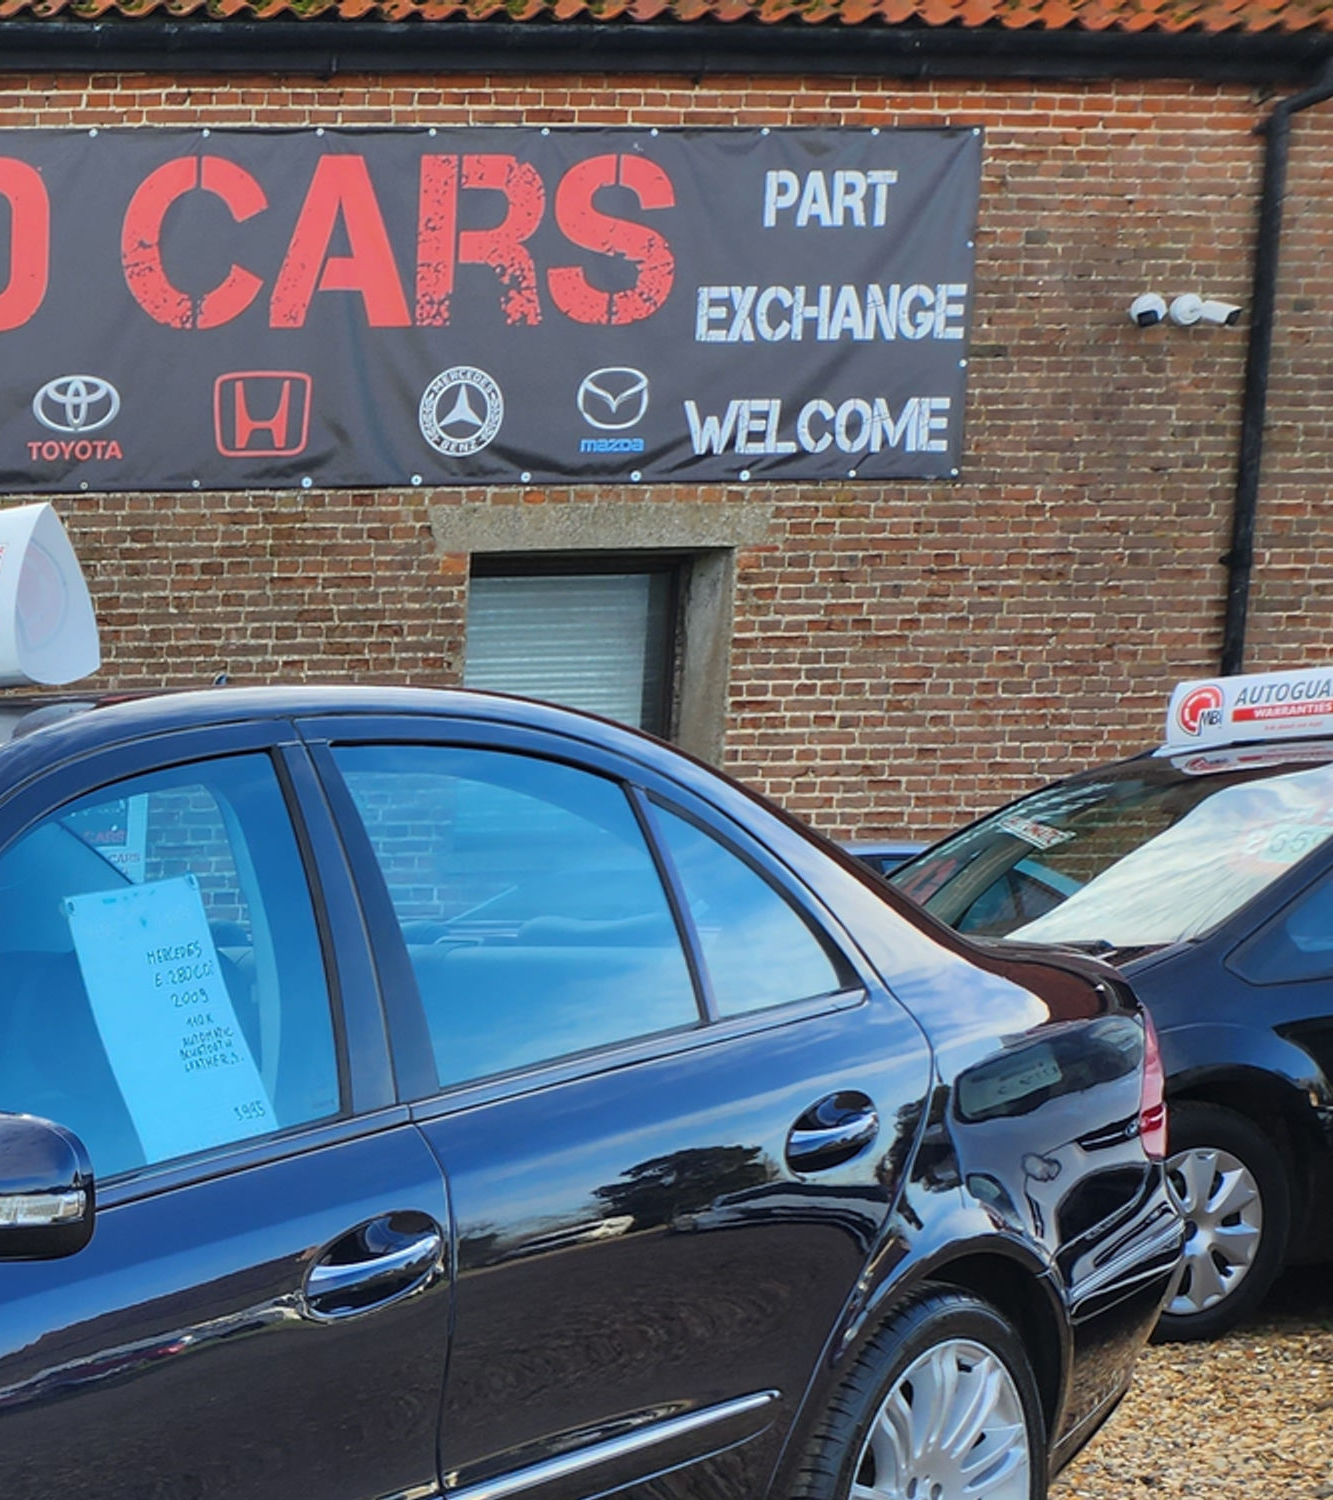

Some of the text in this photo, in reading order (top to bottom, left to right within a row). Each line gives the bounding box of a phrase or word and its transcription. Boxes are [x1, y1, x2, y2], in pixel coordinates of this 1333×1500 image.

[764, 170, 898, 228] PART
[122, 152, 676, 330] CARS
[695, 283, 969, 343] EXCHANGE
[579, 436, 645, 453] mazda
[684, 397, 951, 456] WELCOME
[27, 440, 123, 462] TOYOTA
[1235, 678, 1333, 707] AUTOGUA
[146, 940, 203, 966] MERCEDES
